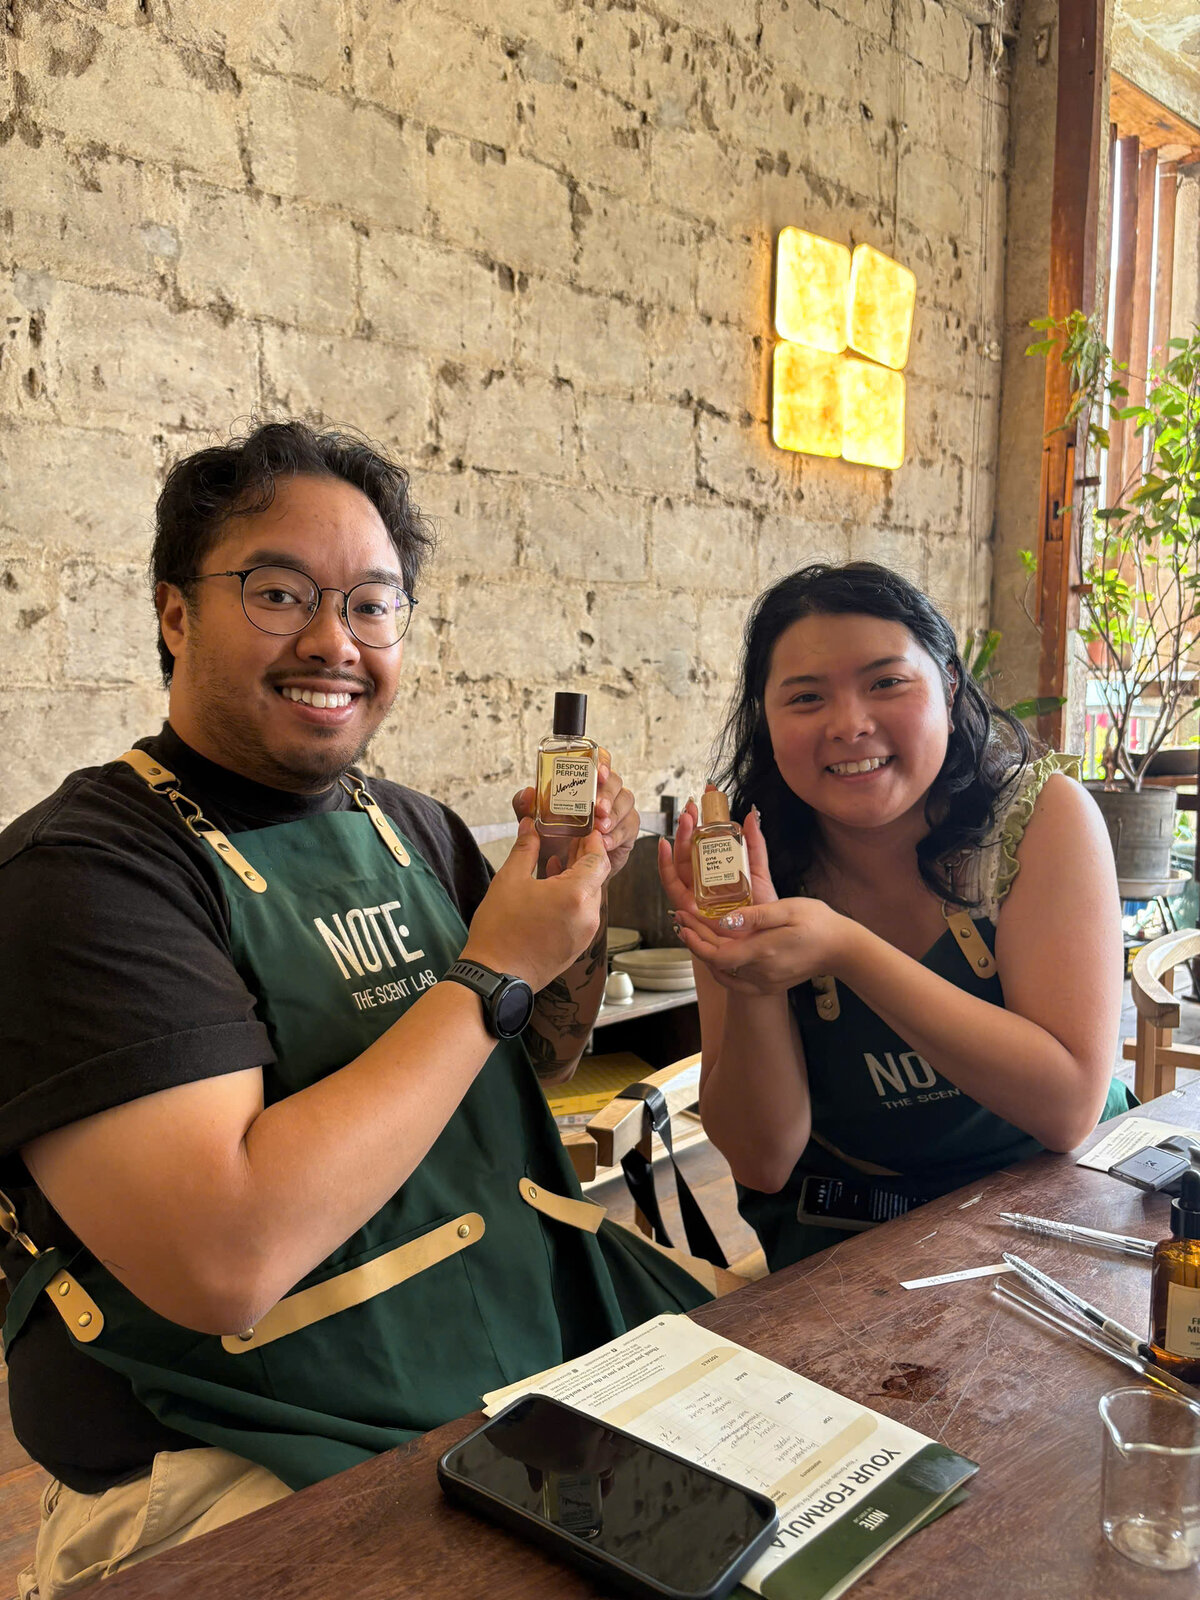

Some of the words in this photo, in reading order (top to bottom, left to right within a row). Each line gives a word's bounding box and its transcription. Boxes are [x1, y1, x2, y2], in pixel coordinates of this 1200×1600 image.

[556, 763, 589, 771] BESPOKE
[702, 842, 731, 850] BESPOKE
[703, 847, 732, 855] PERFUME
[313, 900, 425, 980] NOTE
[352, 989, 377, 1010] THE
[376, 978, 411, 1004] SCENT
[411, 969, 438, 992] LAB
[881, 1098, 913, 1110] THE
[644, 1347, 660, 1357] Thank
[633, 1353, 644, 1362] you
[701, 1355, 719, 1367] TOTALS
[624, 1359, 636, 1368] and
[605, 1368, 617, 1377] you
[734, 1371, 748, 1382] BASE
[581, 1381, 593, 1390] next
[593, 1376, 603, 1385] the
[775, 1391, 794, 1405] MIDDLE
[823, 1416, 833, 1425] TOP
[848, 1448, 901, 1485] YOUR
[770, 1482, 856, 1548] FORMULA
[859, 1509, 890, 1531] NOTE
